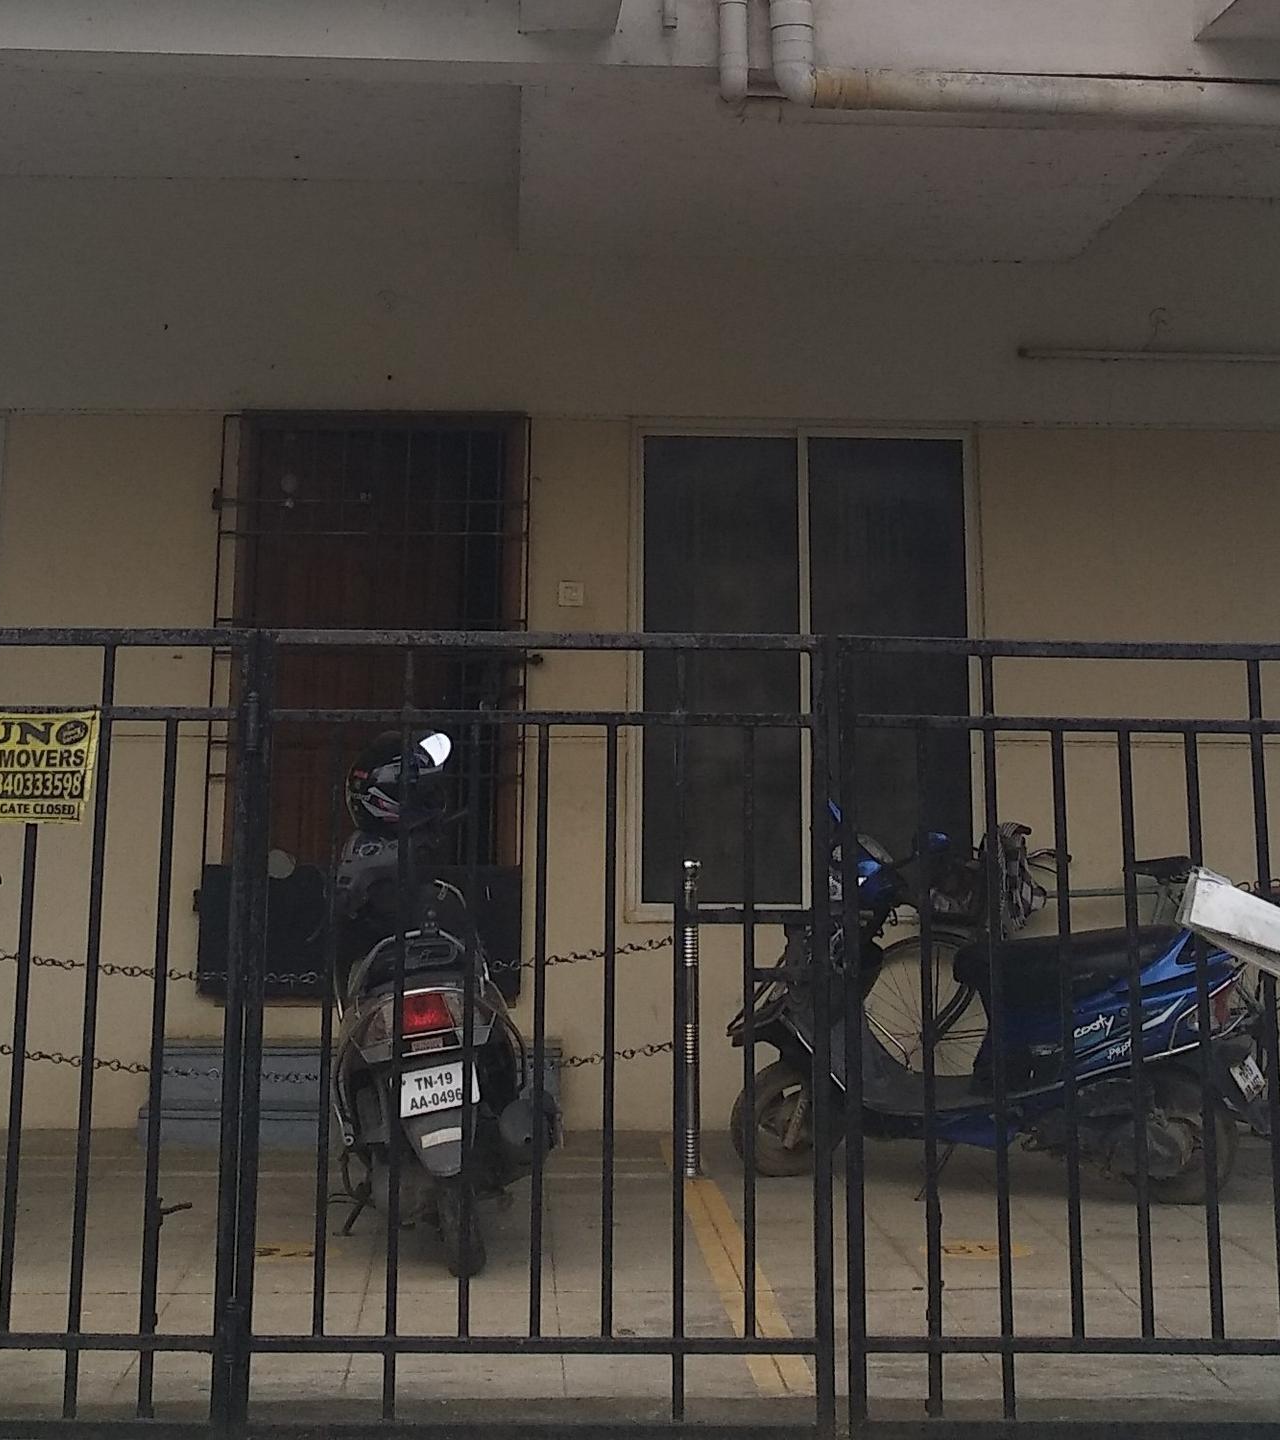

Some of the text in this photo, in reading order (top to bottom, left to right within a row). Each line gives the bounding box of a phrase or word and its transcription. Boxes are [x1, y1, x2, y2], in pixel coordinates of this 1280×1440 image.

[0, 749, 85, 768] MOVERS
[0, 803, 31, 814] GATE
[33, 803, 76, 815] CLOSED
[1073, 1014, 1114, 1038] cooty
[414, 1072, 453, 1091] TN-19
[410, 1088, 463, 1110] AA-0496
